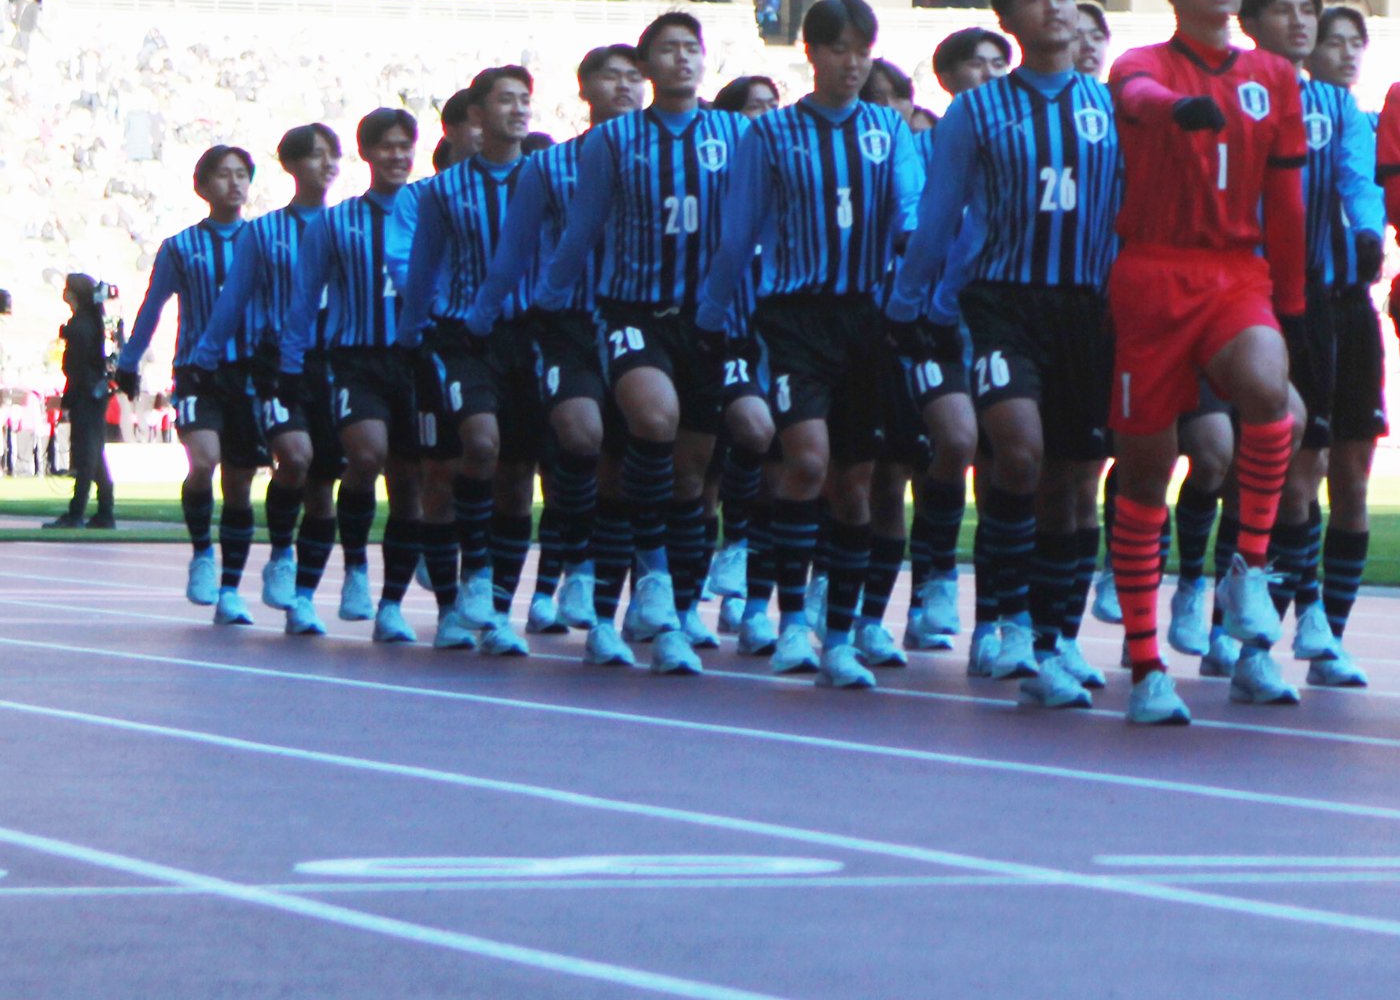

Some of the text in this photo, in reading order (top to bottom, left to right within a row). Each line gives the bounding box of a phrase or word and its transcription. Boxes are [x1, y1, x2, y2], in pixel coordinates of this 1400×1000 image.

[836, 187, 854, 228] 3
[1040, 166, 1077, 211] 26
[664, 195, 699, 234] 20
[609, 326, 646, 360] 20
[975, 349, 1011, 396] 26
[338, 387, 352, 420] 2
